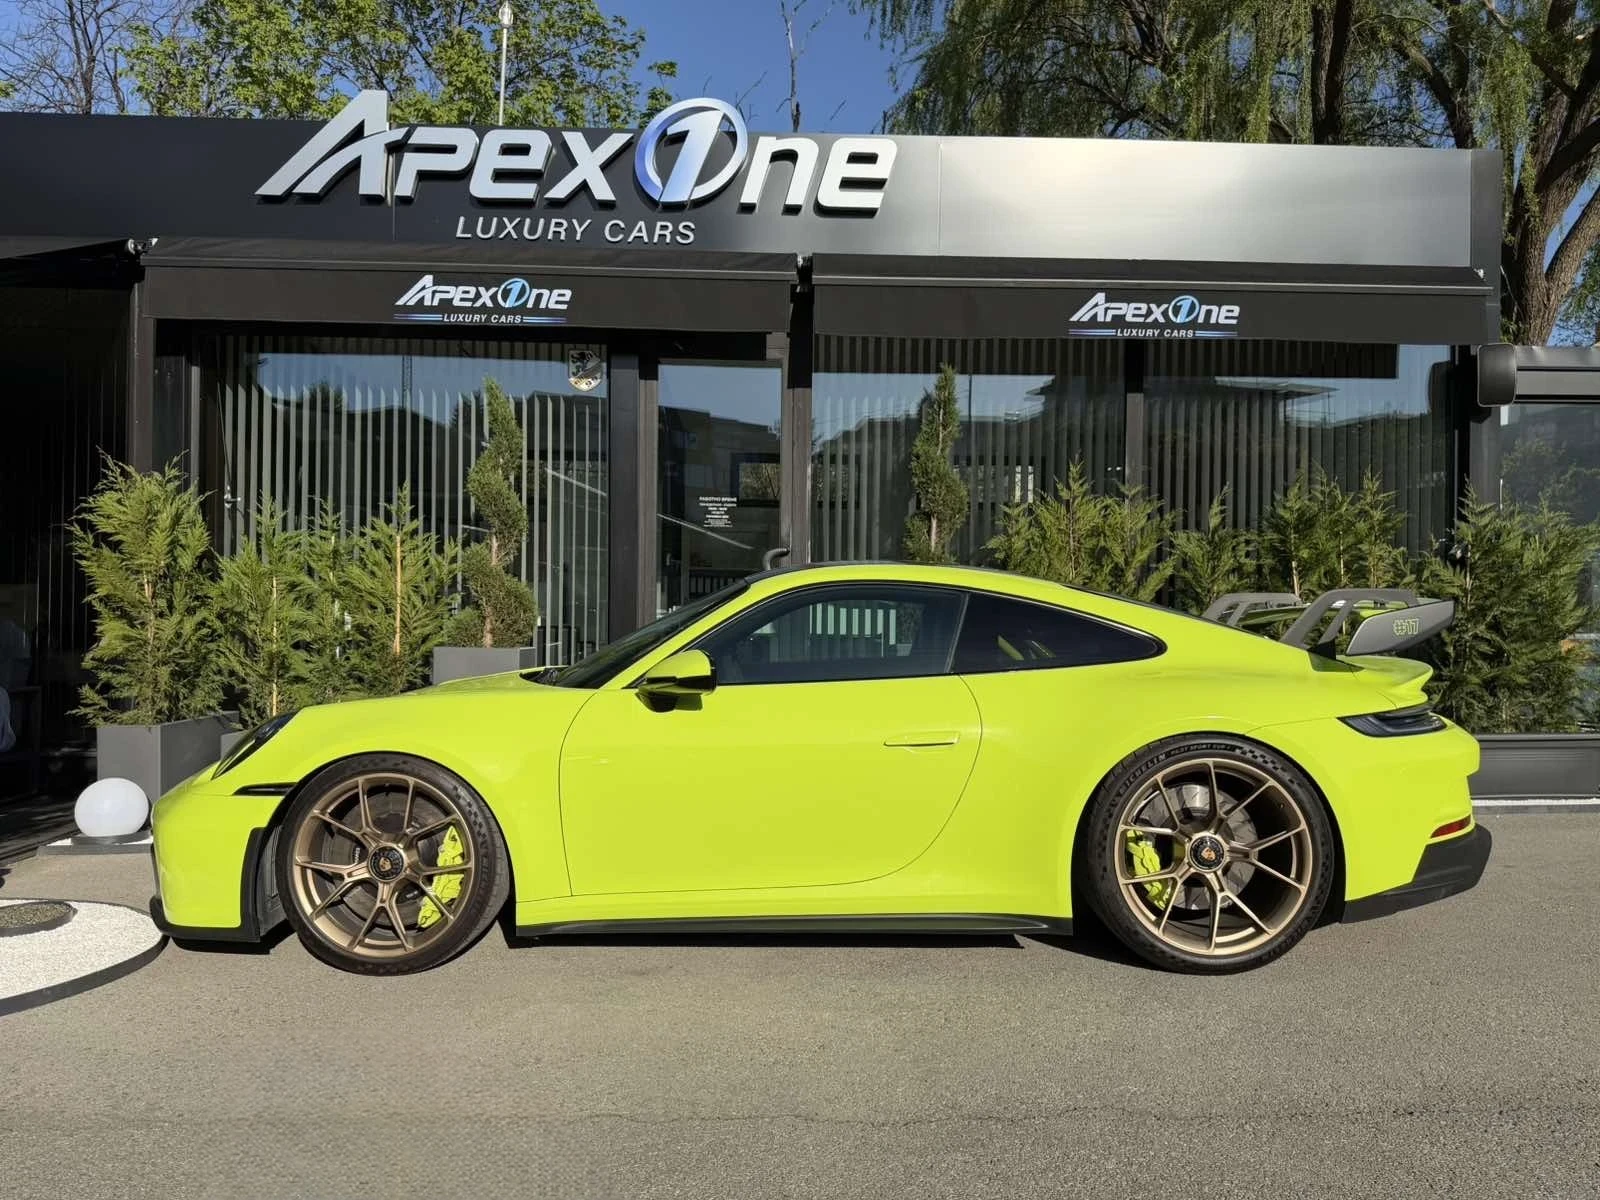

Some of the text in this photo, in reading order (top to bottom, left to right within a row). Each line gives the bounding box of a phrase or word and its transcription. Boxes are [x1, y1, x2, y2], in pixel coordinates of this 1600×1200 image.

[456, 215, 697, 245] LUXURY CARS
[443, 313, 522, 324] LUXURY CARS
[1117, 328, 1194, 338] LUXURY CARS
[1393, 617, 1420, 636] #17
